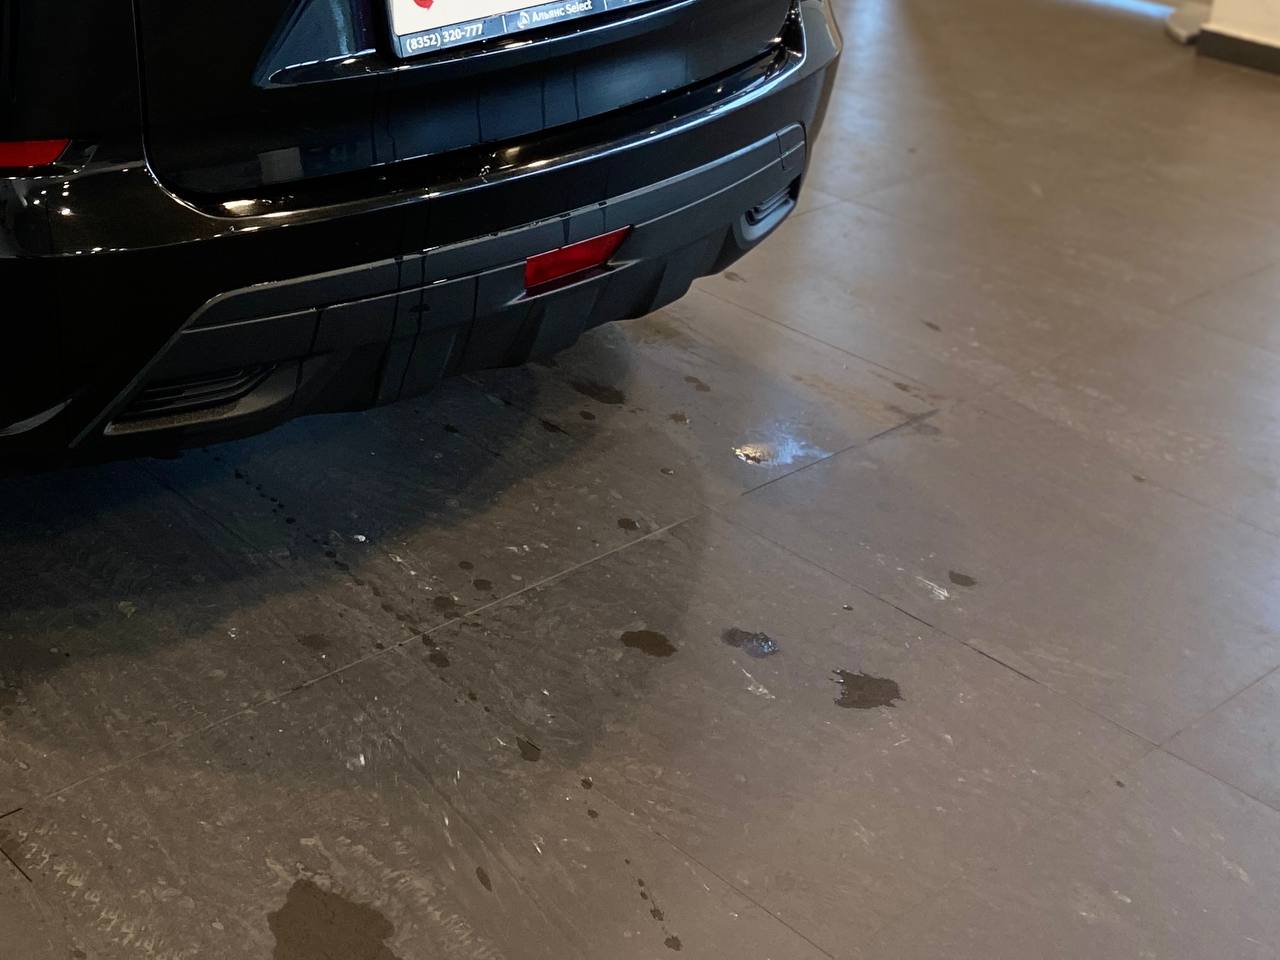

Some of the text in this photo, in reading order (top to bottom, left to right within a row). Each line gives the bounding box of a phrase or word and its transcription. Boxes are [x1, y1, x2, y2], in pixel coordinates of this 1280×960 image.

[532, 0, 593, 23] Альянс Select
[406, 23, 483, 53] (8352) 320-777
